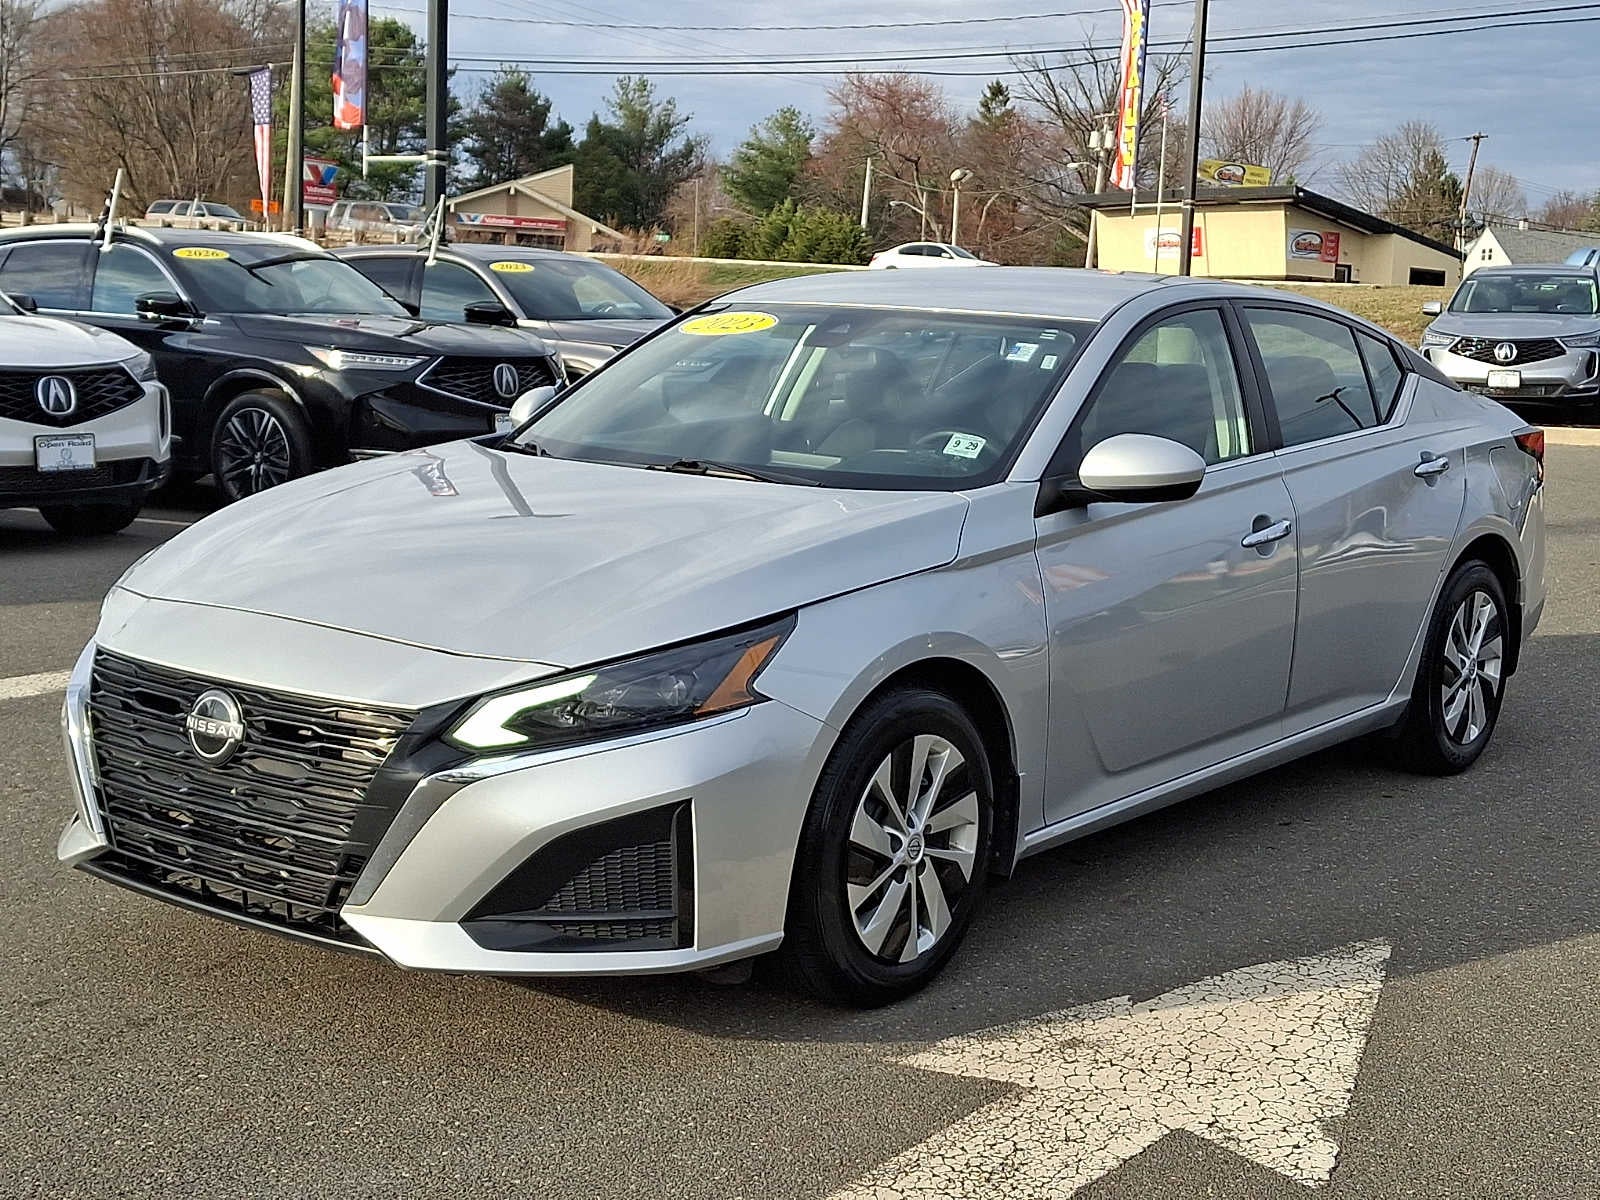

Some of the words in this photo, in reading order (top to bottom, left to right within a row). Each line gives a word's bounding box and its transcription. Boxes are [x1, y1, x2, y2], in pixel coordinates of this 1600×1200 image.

[39, 440, 65, 449] Open
[67, 440, 92, 448] Road
[952, 439, 961, 448] 9
[964, 441, 979, 451] 29
[186, 715, 243, 740] NISSAN
